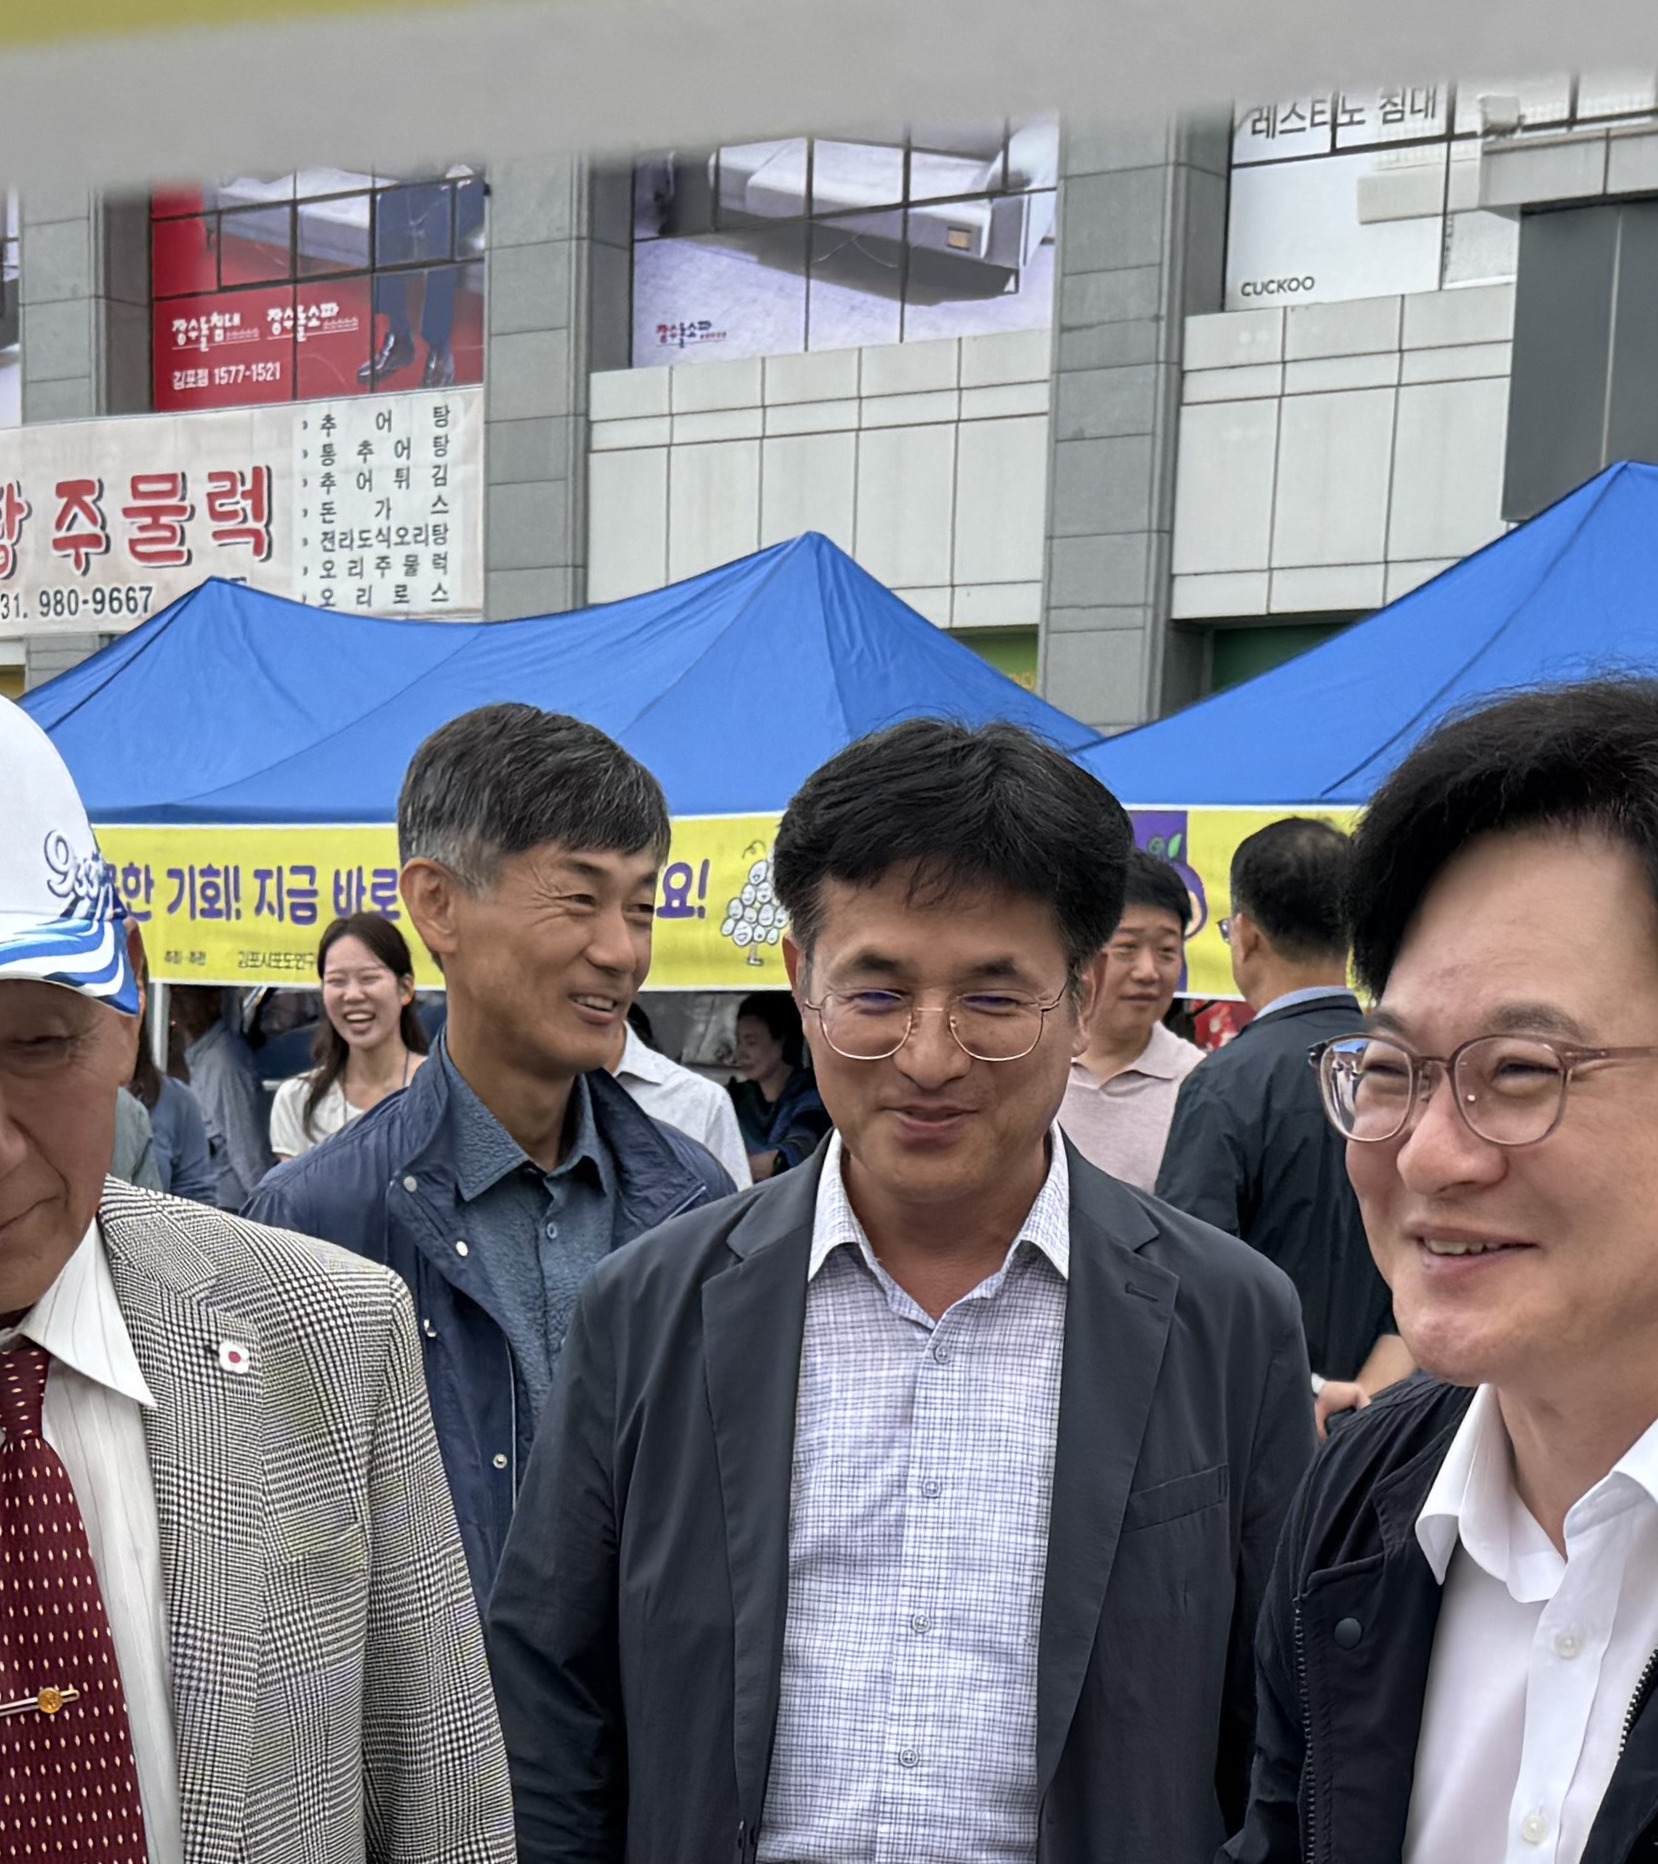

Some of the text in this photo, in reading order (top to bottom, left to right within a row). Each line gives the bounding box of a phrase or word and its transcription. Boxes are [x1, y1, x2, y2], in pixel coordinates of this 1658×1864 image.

[1241, 276, 1316, 297] CUCKOO
[214, 362, 281, 385] 1577-1521
[50, 465, 274, 578] 주물럭
[320, 522, 448, 553] 전라도식오리탕
[39, 586, 154, 617] 980-9667
[166, 862, 242, 923] 기회!
[253, 864, 320, 926] 지금
[332, 865, 402, 923] 바로
